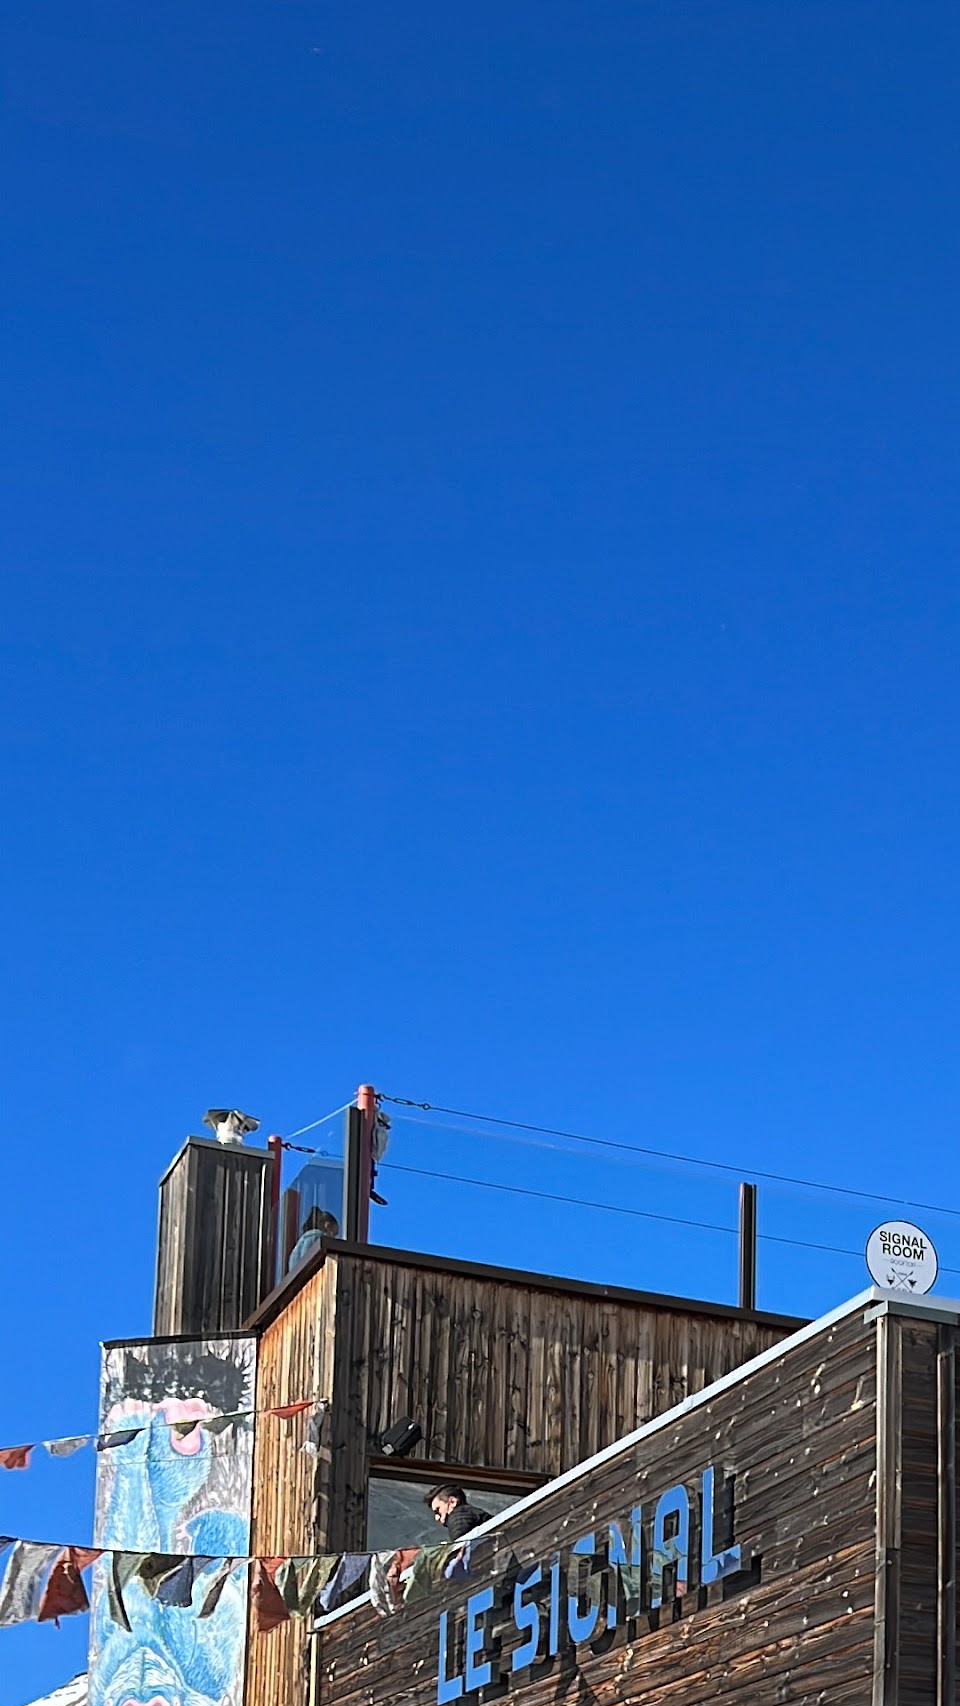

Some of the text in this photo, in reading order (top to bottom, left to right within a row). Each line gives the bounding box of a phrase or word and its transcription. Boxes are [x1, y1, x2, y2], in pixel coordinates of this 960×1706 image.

[879, 1230, 927, 1249] SIGNAL
[882, 1243, 924, 1261] ROOM
[436, 1464, 743, 1706] LE SIGNAL
